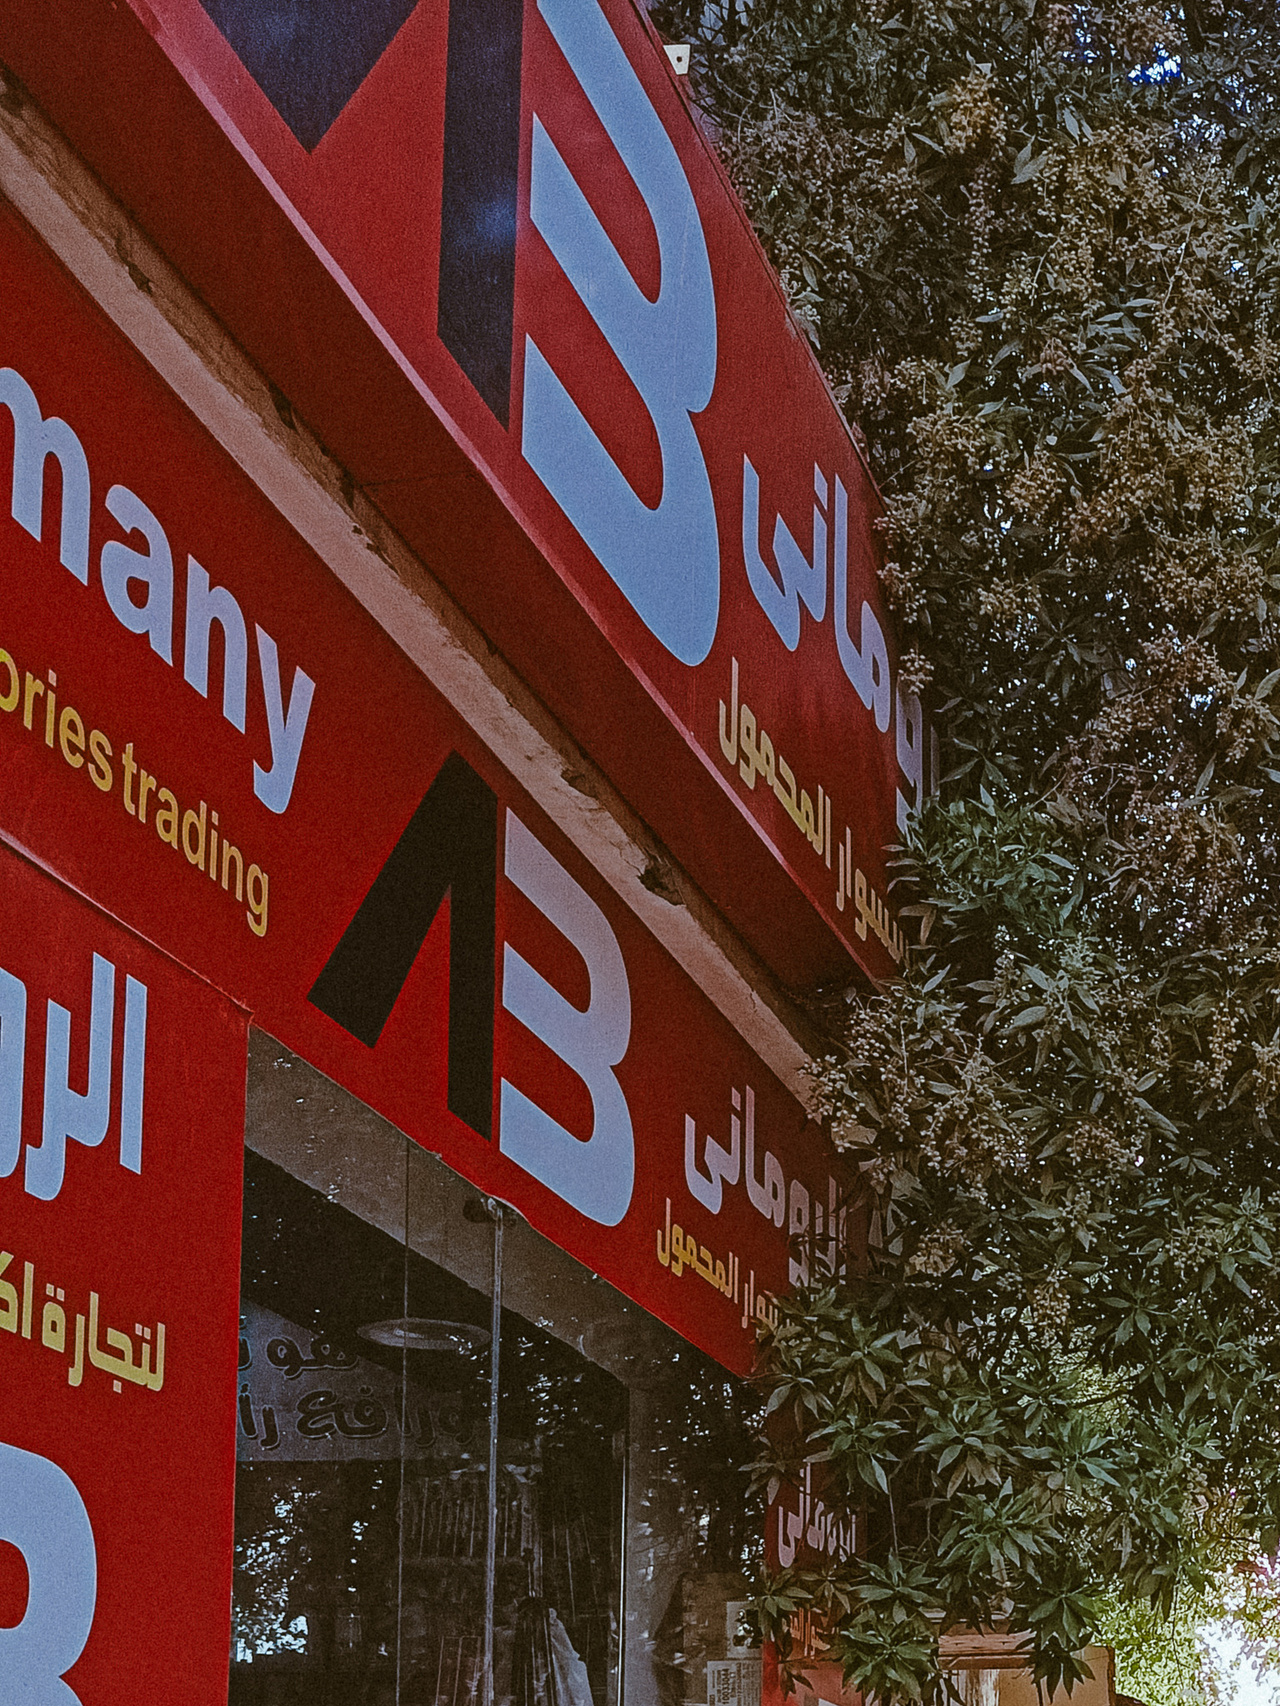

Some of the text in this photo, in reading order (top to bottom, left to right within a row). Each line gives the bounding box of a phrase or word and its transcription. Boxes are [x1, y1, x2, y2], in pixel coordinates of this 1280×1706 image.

[121, 742, 270, 938] trading
[718, 656, 832, 870] المحمول
[656, 1197, 739, 1305] المحمول
[42, 1282, 166, 1394] لتجارة
